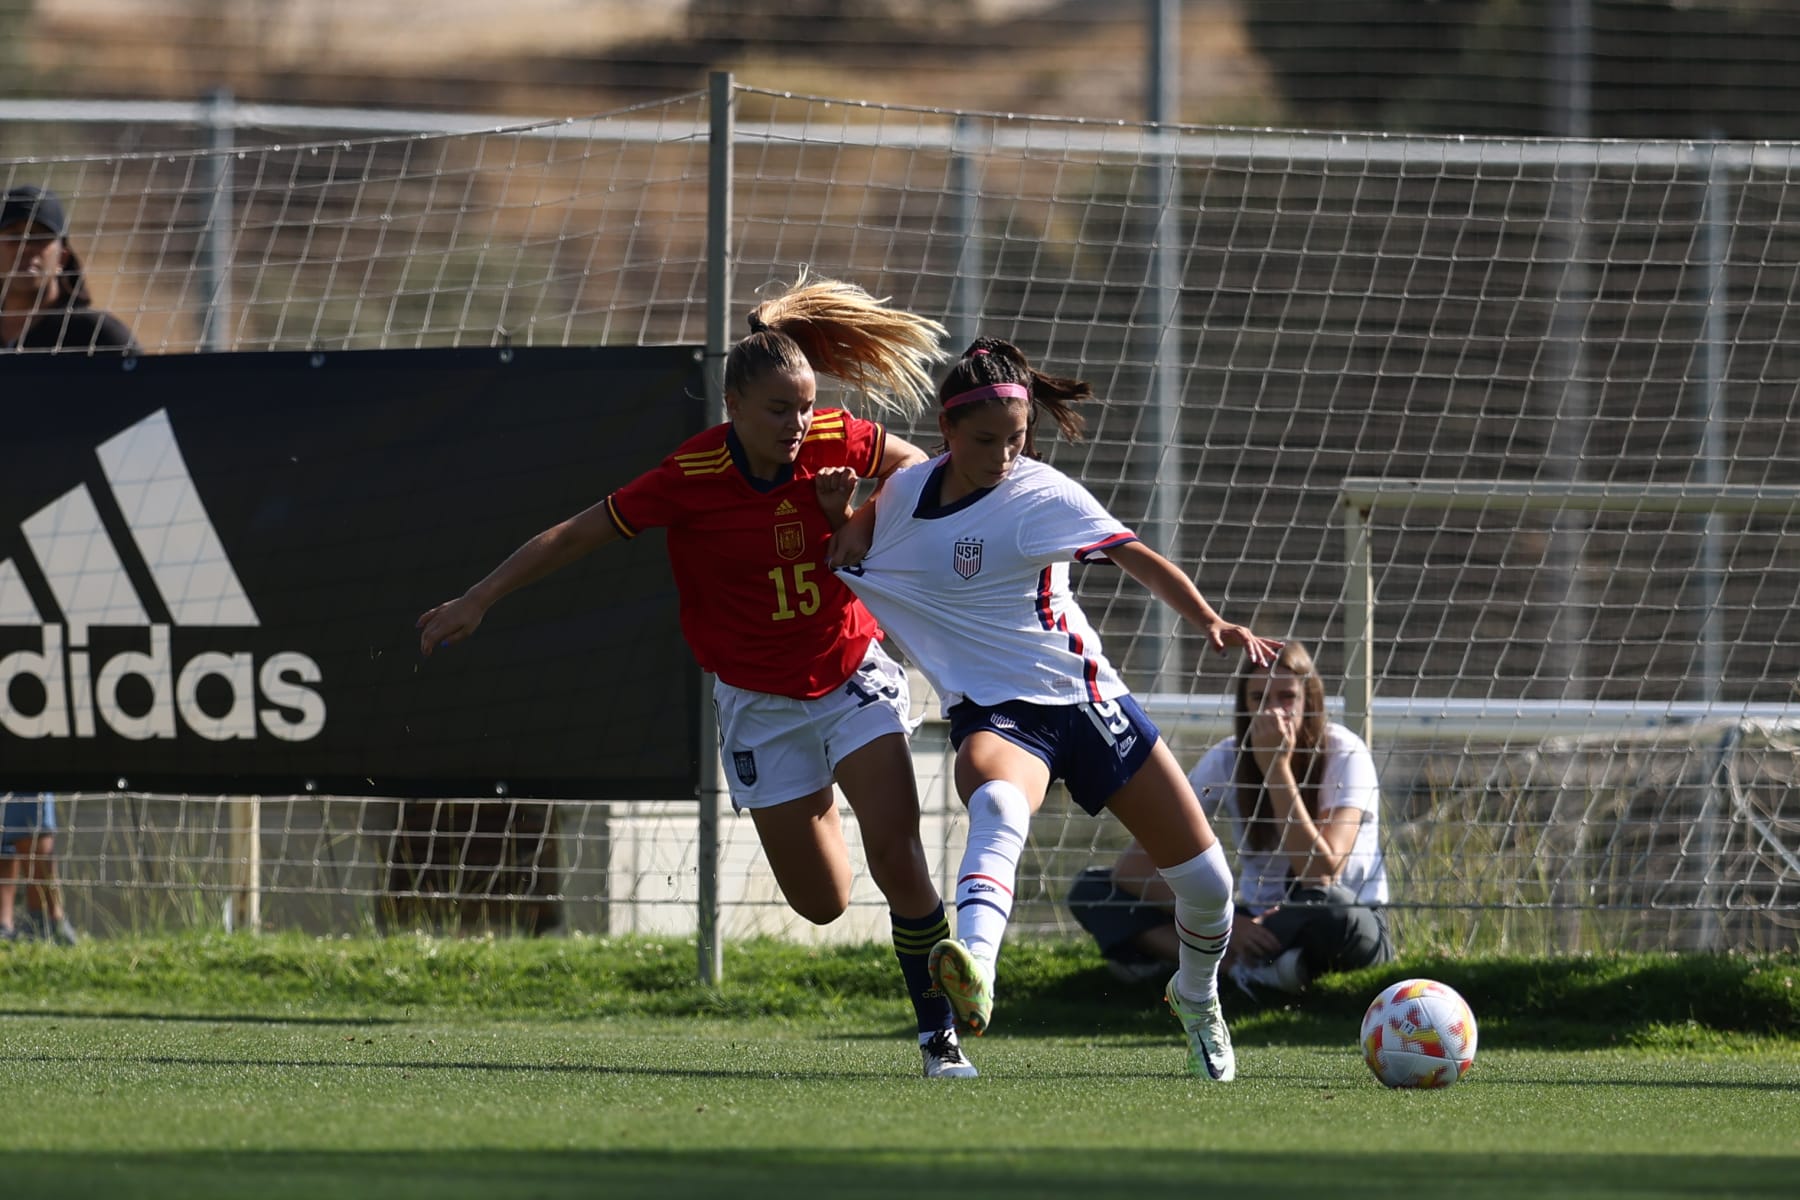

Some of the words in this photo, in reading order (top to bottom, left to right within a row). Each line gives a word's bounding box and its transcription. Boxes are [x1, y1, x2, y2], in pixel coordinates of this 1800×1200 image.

[957, 545, 980, 559] USA
[768, 562, 820, 621] 15
[0, 623, 327, 741] didas
[1077, 699, 1130, 747] 19
